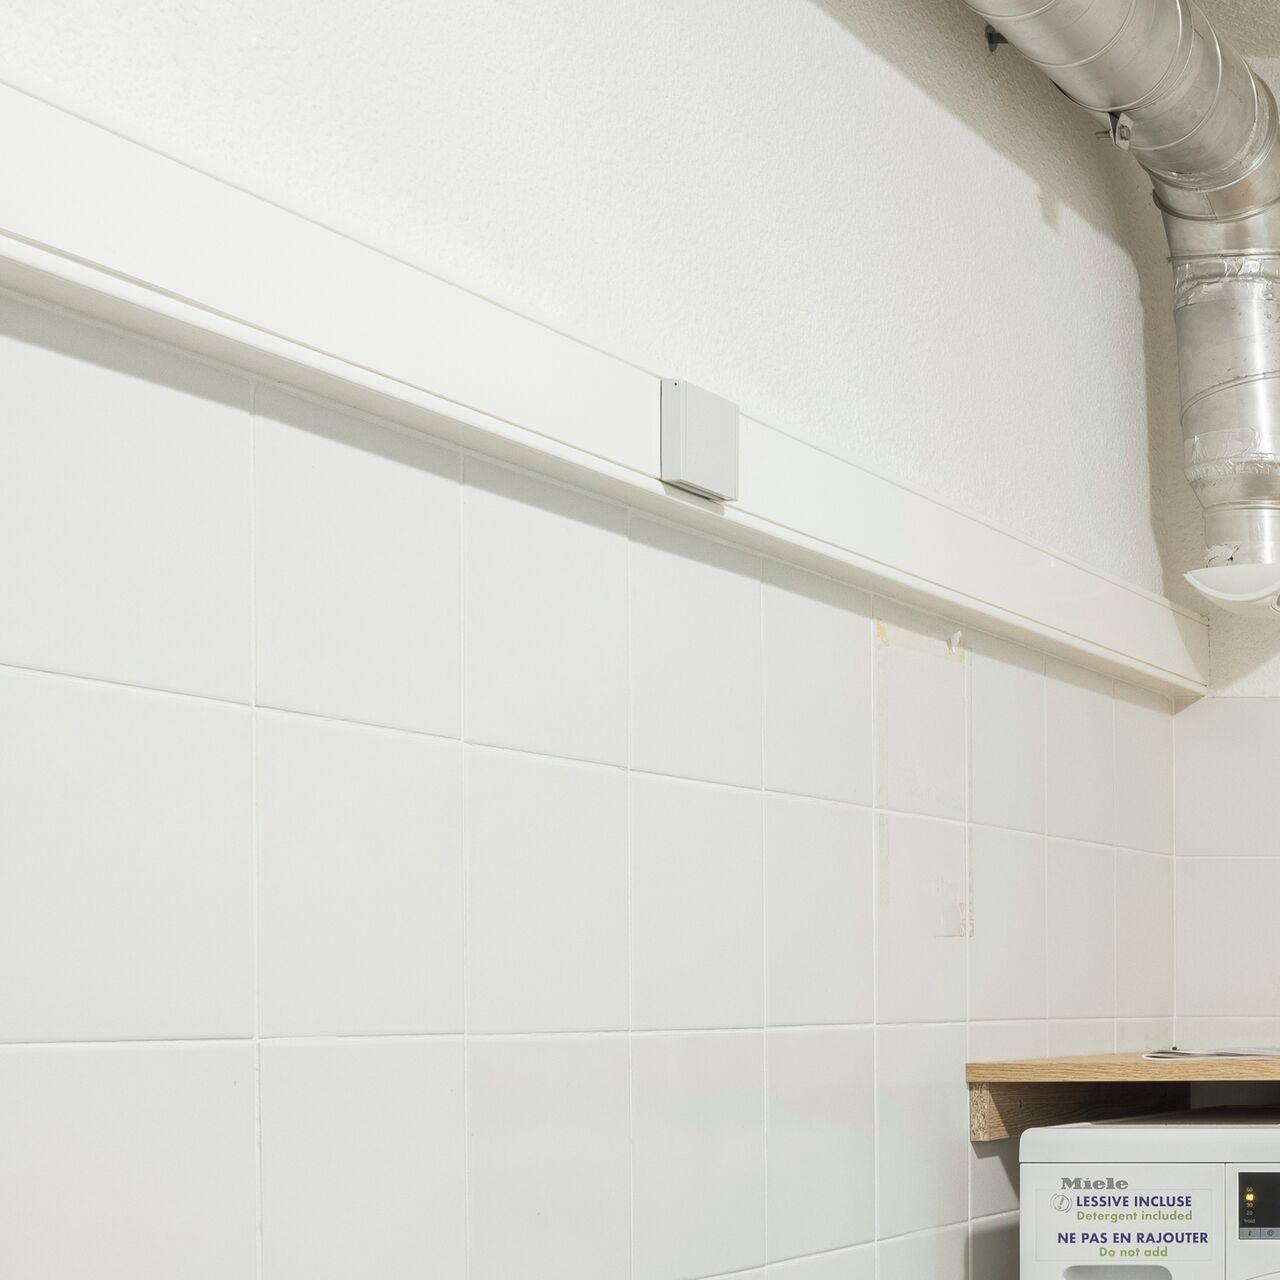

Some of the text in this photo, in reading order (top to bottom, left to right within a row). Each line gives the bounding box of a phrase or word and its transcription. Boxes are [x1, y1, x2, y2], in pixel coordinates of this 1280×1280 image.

[1061, 1177, 1129, 1190] Miele
[1076, 1196, 1192, 1207] LESSIVE INCLUSE
[1076, 1210, 1192, 1223] Detergent included
[1058, 1232, 1208, 1243] NE PAS EN RAJOUTER
[1099, 1246, 1168, 1257] Do not add
